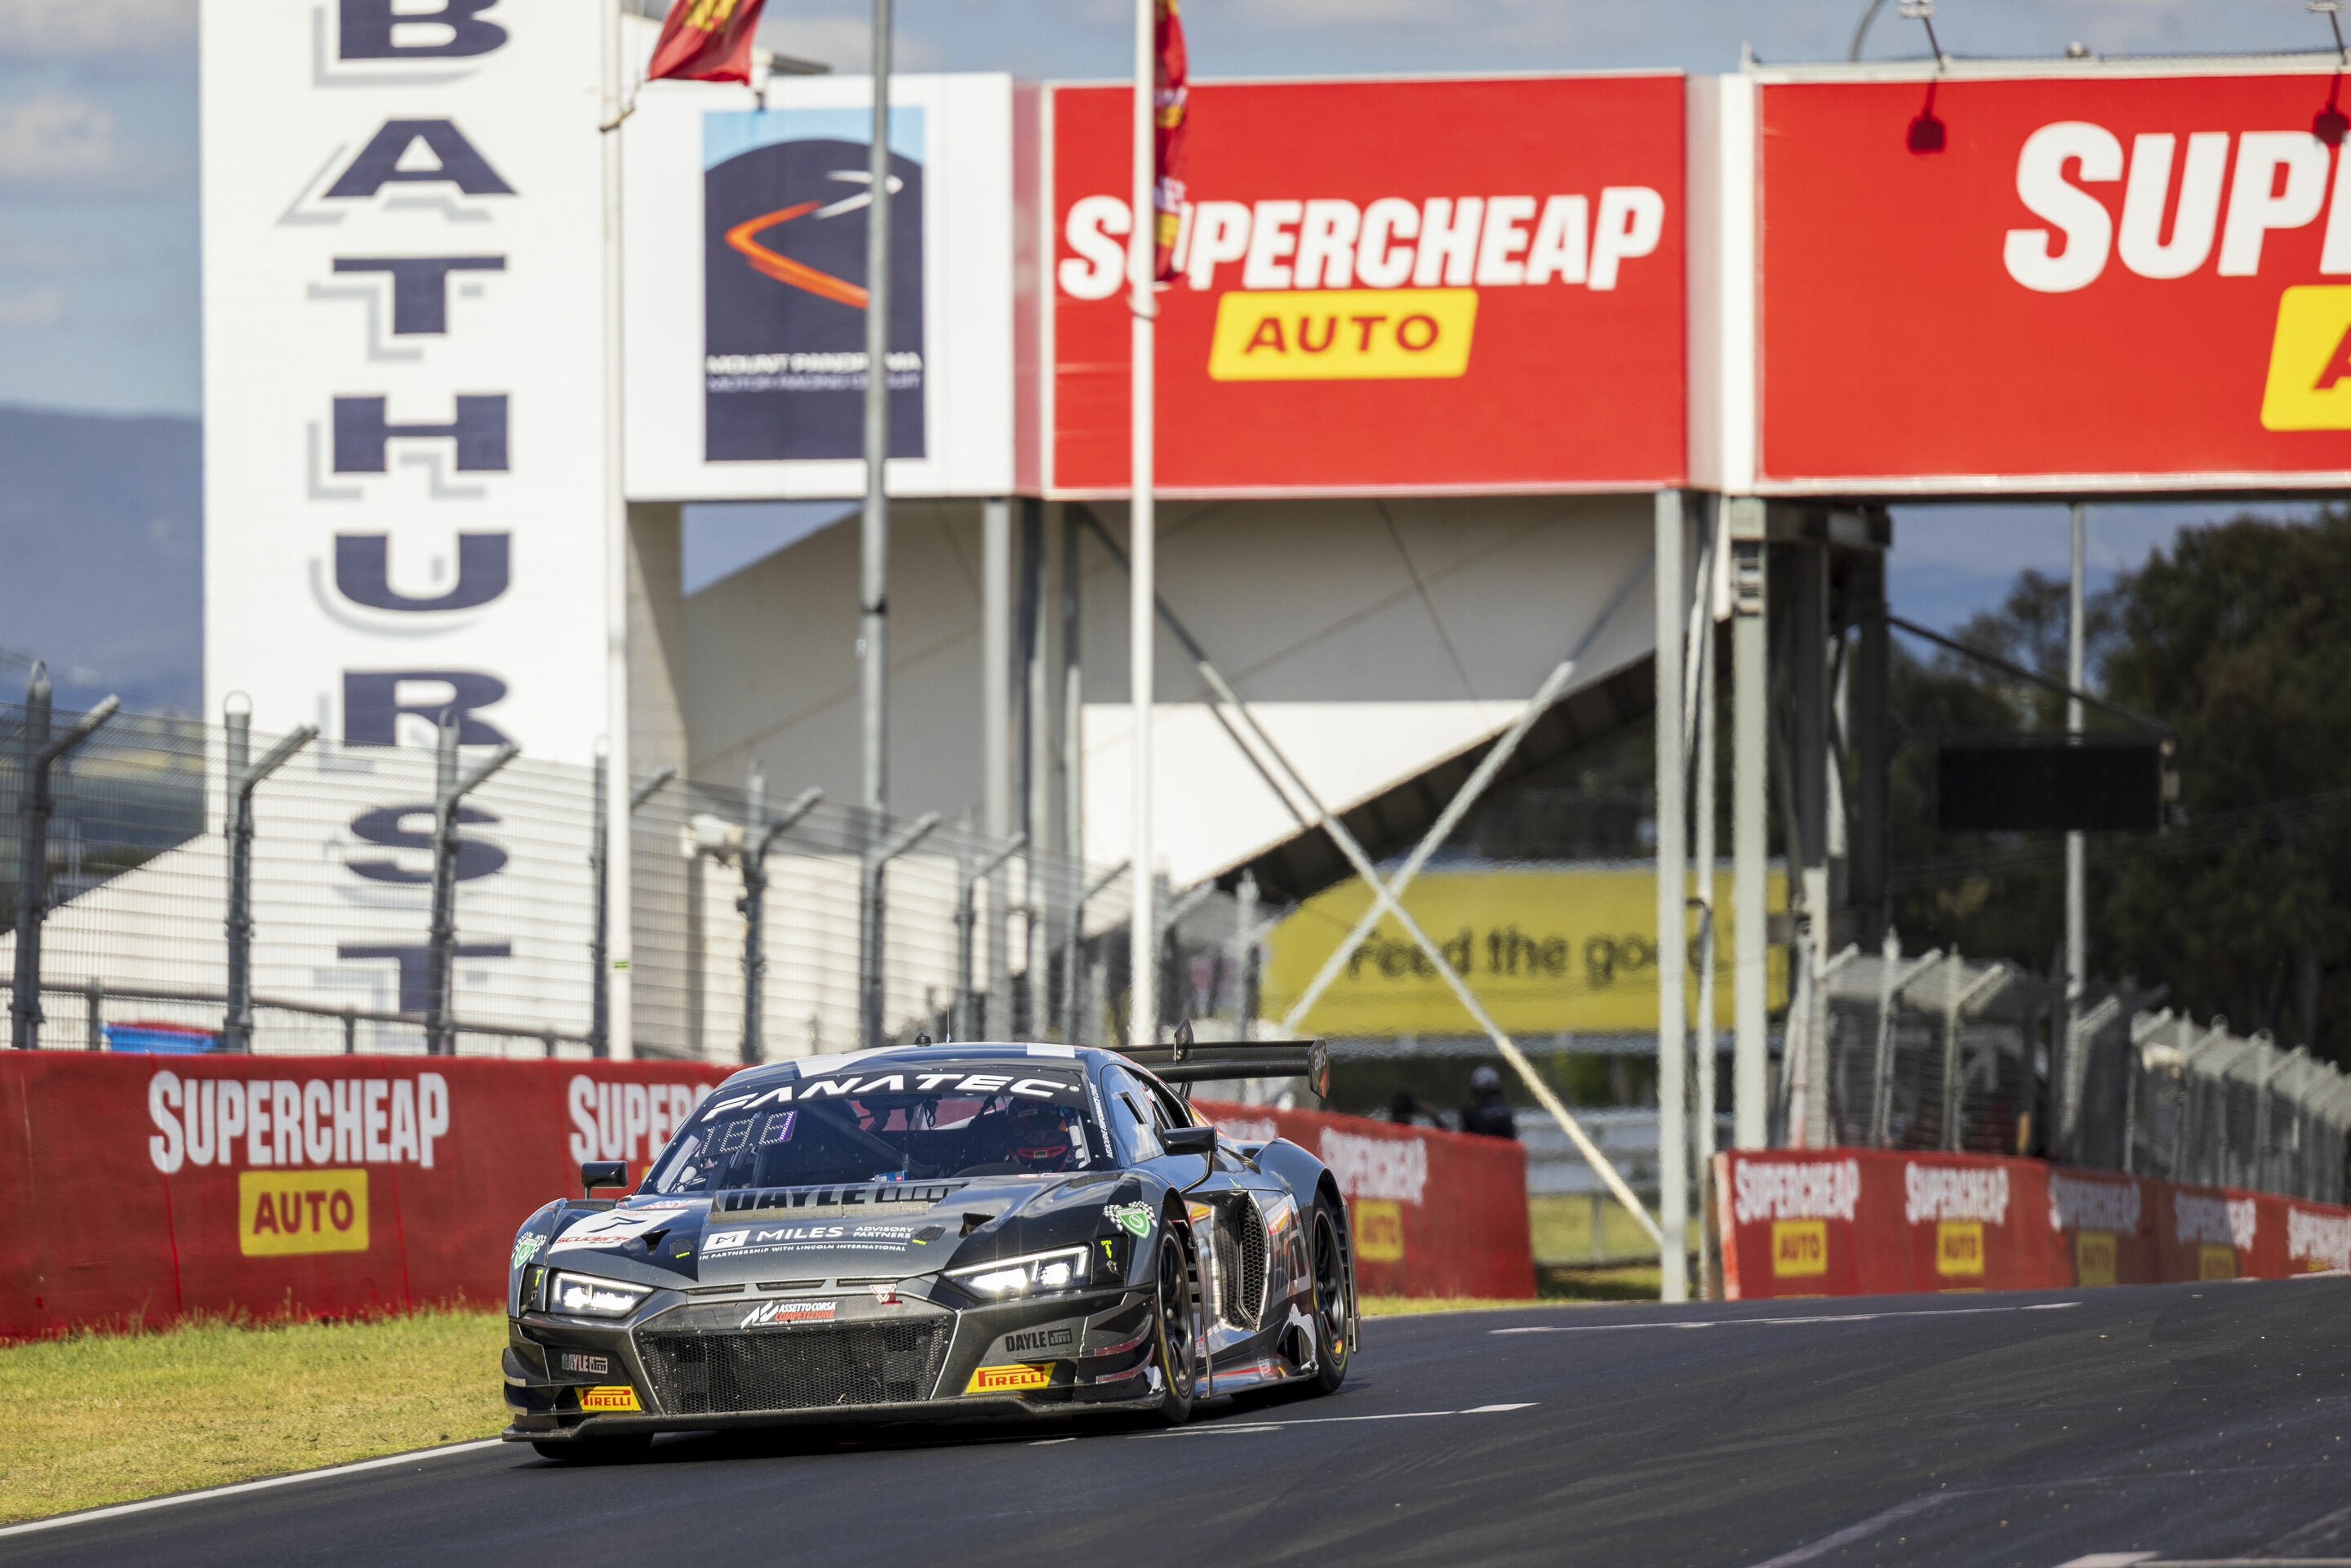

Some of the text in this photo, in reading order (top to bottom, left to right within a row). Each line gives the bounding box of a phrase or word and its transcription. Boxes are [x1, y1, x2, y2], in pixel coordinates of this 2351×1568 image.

[1244, 314, 1439, 353] AUTO
[322, 0, 521, 1011] BATHURST
[1486, 923, 1569, 975] the
[700, 1074, 1067, 1122] FANATEC
[148, 1069, 449, 1174] SUPERCHEAP
[252, 1189, 354, 1236] AUTO
[757, 1227, 843, 1242] MILES
[711, 1247, 768, 1259] PARTNERSHIP
[836, 1243, 906, 1251] INTERNATIONAL
[775, 1309, 836, 1321] COMPETIZIONE
[778, 1301, 836, 1313] ASSETTO CORSA
[1005, 1331, 1047, 1352] DAYLE
[562, 1353, 588, 1372] DAYLE
[978, 1366, 1045, 1387] PIRELLI
[584, 1389, 631, 1406] PIRELLI
